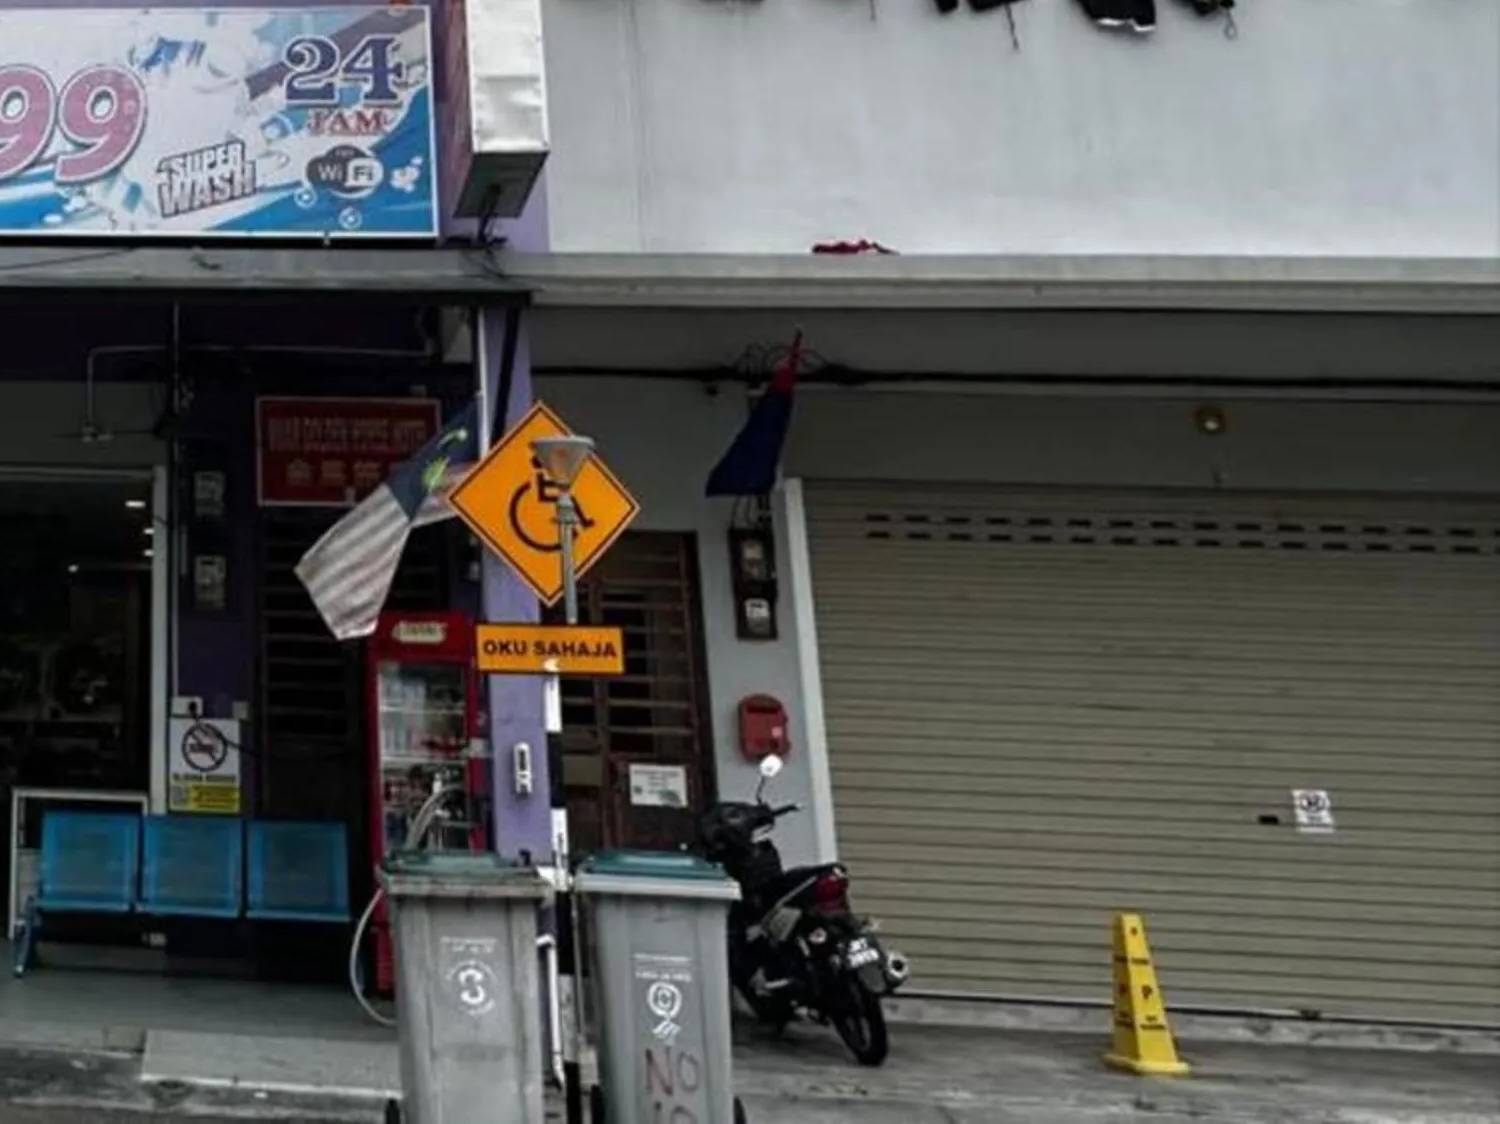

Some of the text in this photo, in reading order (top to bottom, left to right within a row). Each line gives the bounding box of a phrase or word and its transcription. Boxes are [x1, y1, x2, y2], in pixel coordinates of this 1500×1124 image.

[283, 34, 406, 106] 24
[308, 108, 386, 135] JAM
[157, 140, 244, 178] SUPER
[483, 640, 617, 657] OKU SAHAJA
